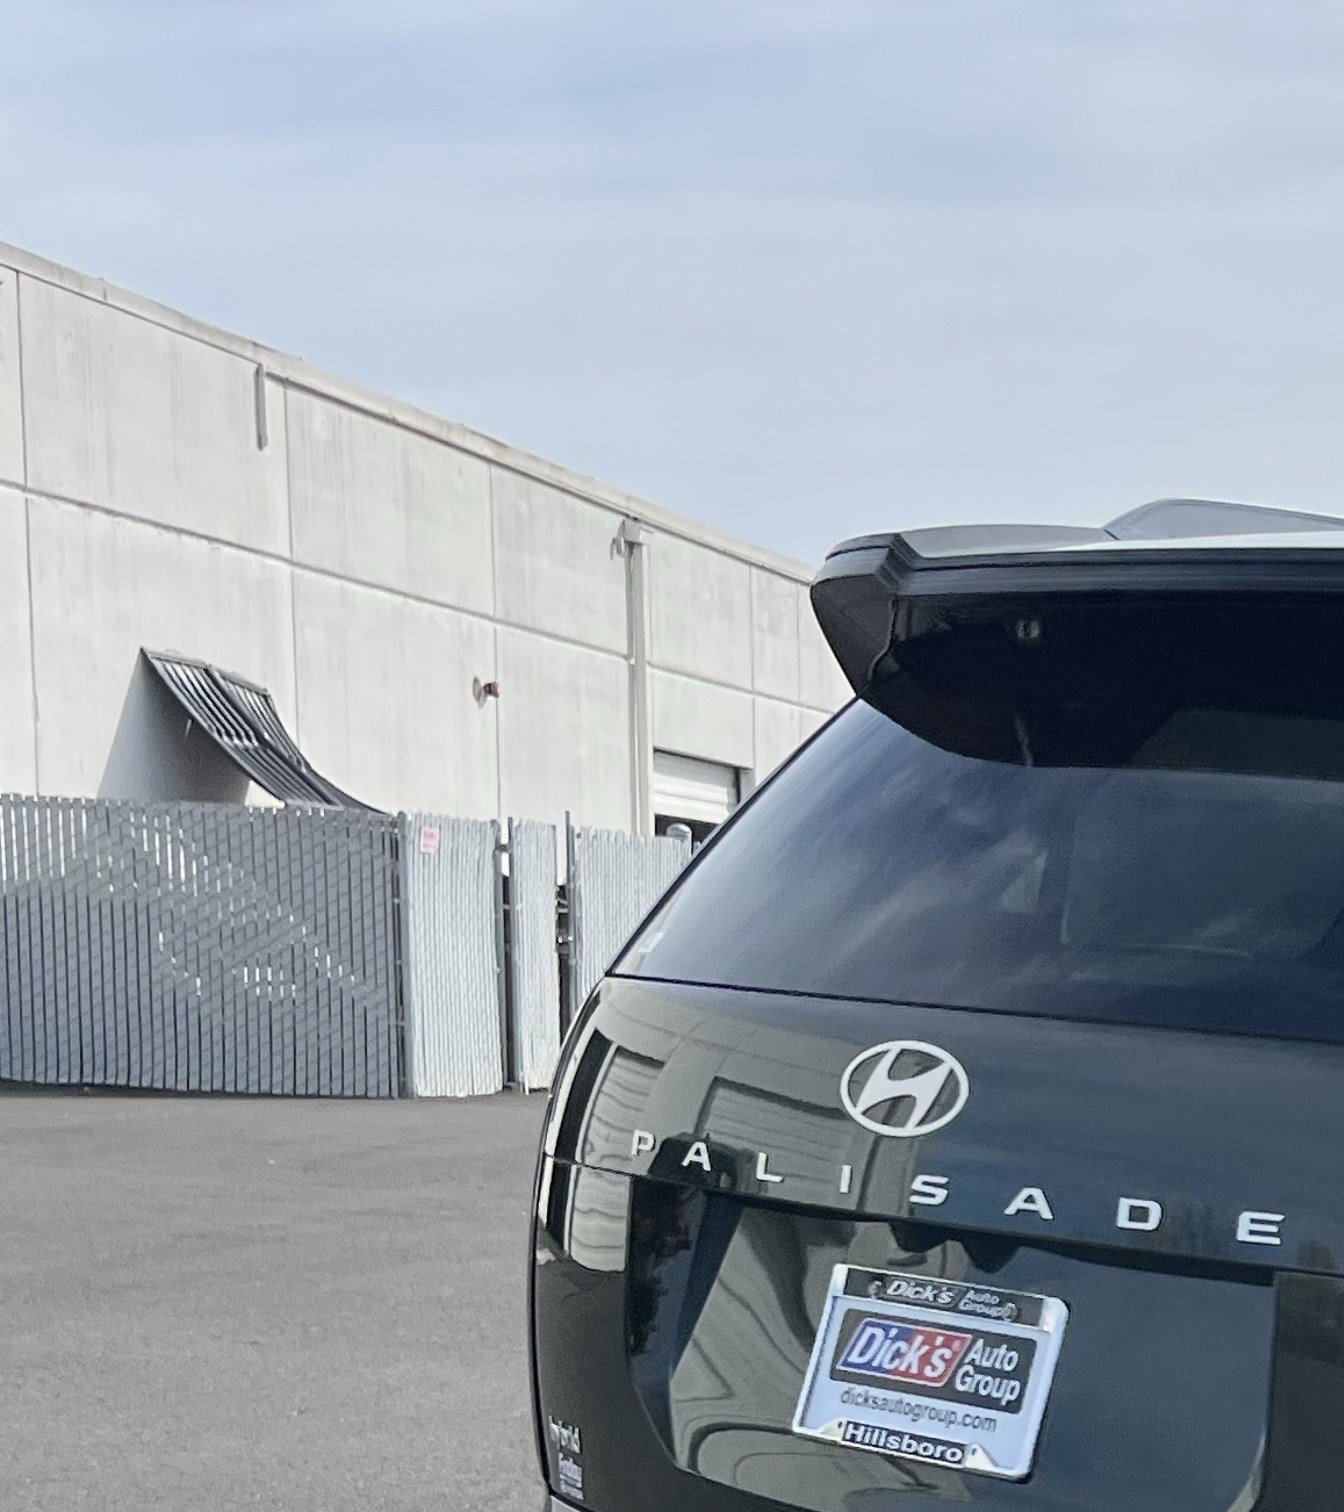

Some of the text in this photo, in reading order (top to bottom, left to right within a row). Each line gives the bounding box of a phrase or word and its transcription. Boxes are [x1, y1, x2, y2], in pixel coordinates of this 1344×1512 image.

[631, 1129, 1286, 1246] PALISADE
[886, 1280, 956, 1305] Dick's
[848, 1326, 1020, 1379] Dick's Auto
[954, 1364, 1023, 1407] Group
[840, 1385, 998, 1433] dicksautogroup.com
[845, 1422, 964, 1463] Hillsboro
